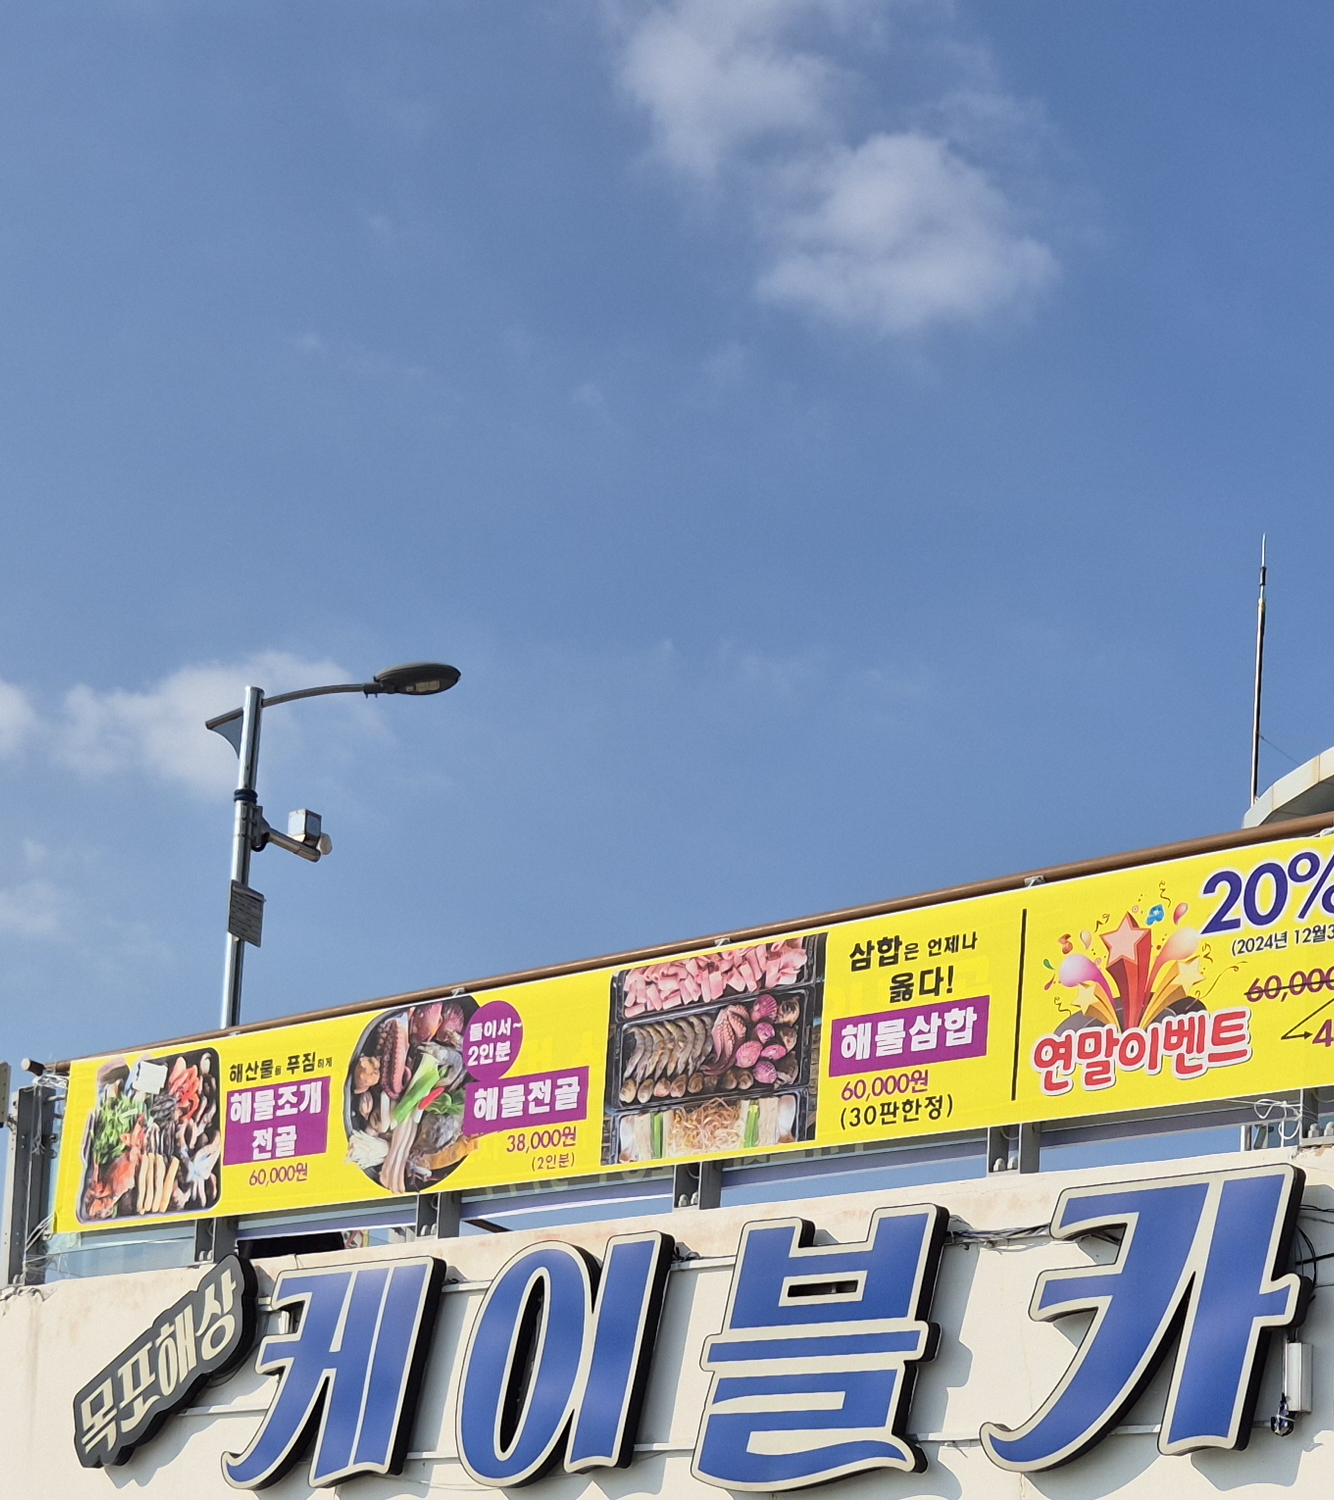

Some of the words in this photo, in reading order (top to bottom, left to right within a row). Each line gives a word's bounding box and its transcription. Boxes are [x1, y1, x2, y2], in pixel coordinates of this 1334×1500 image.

[849, 935, 920, 973] 삼합은
[927, 931, 978, 957] 언제나
[1231, 933, 1288, 958] (2024년
[889, 965, 954, 1004] 옳다!
[840, 1006, 978, 1061] 해물삼합
[1032, 1009, 1250, 1093] 연말이벤트
[467, 1041, 511, 1066] 2인분
[230, 1081, 323, 1124] 해물조개
[473, 1076, 581, 1121] 해물전골
[840, 1069, 930, 1102] 60,000원
[840, 1093, 954, 1131] (30판한정)
[252, 1125, 297, 1160] 전골
[506, 1125, 577, 1154] 38,000원
[248, 1162, 308, 1187] 60,000원
[531, 1152, 576, 1172] (2인분)
[220, 1165, 1312, 1492] 케이블카
[80, 1267, 238, 1456] 목포해상
